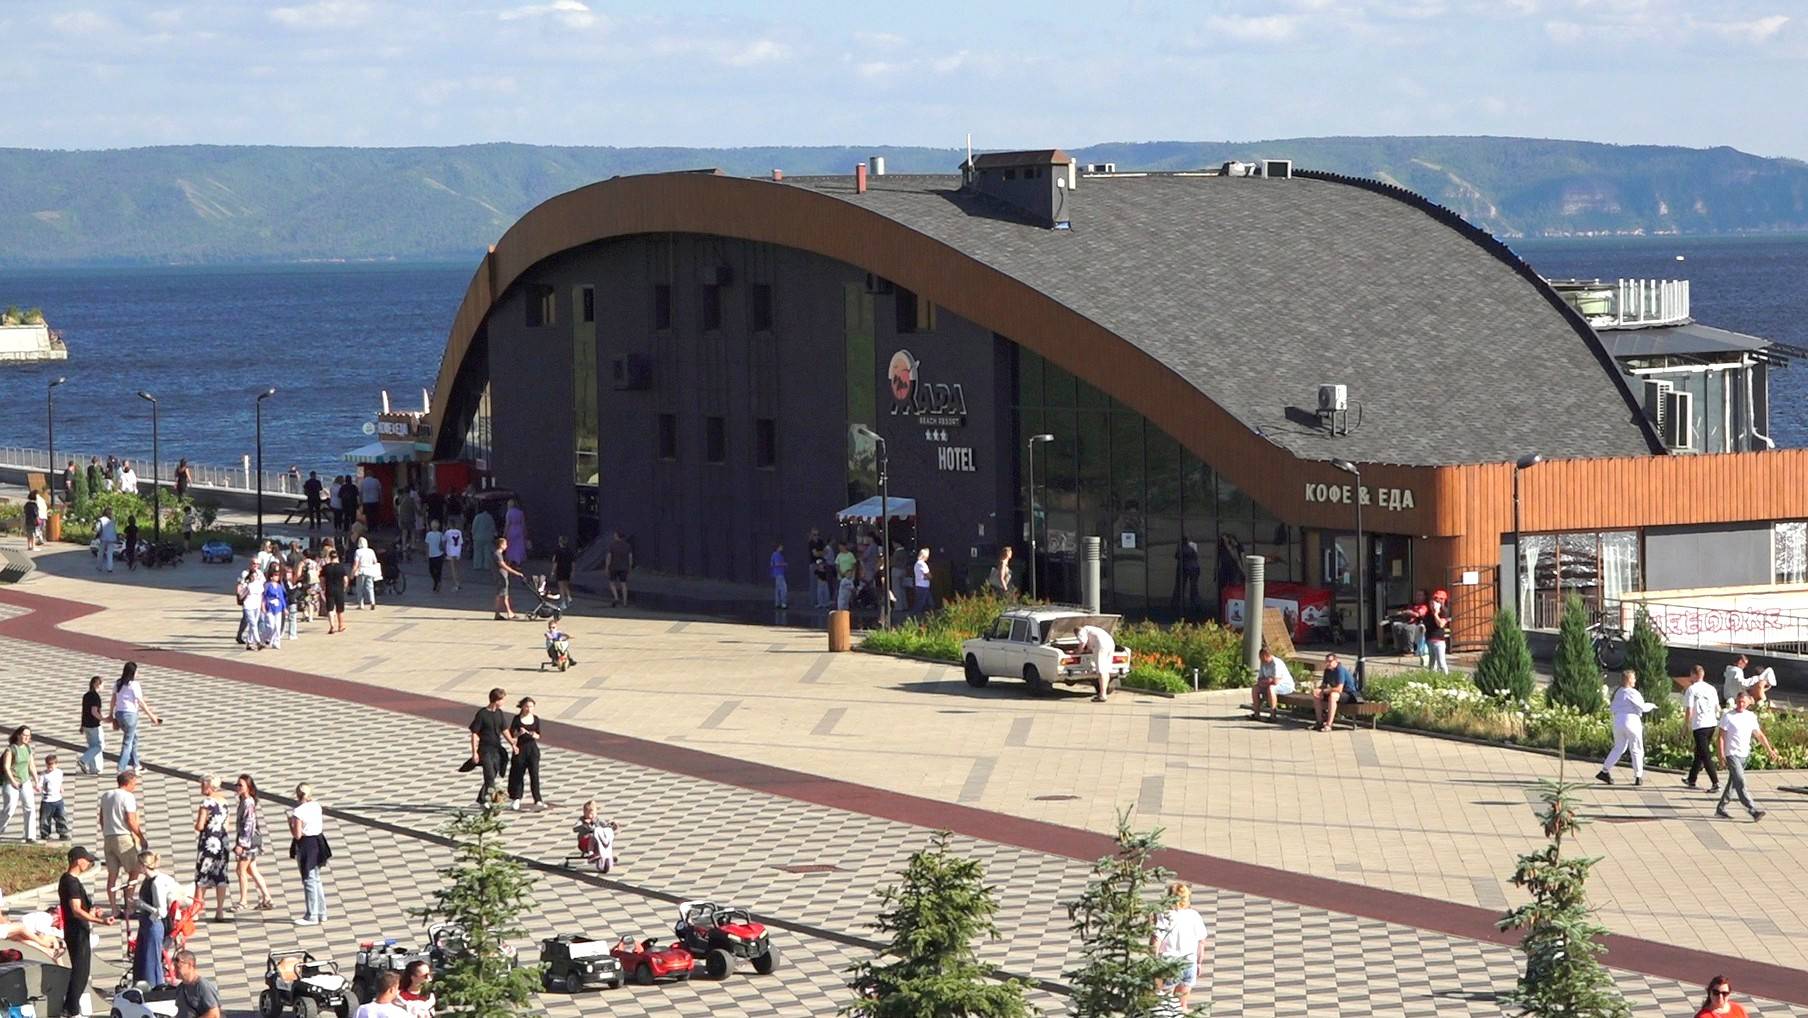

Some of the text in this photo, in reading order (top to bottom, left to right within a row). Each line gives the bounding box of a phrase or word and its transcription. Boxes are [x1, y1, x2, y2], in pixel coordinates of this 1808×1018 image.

[938, 446, 976, 472] HOTEL
[1305, 483, 1415, 511] КОФЕ & ЕДА
